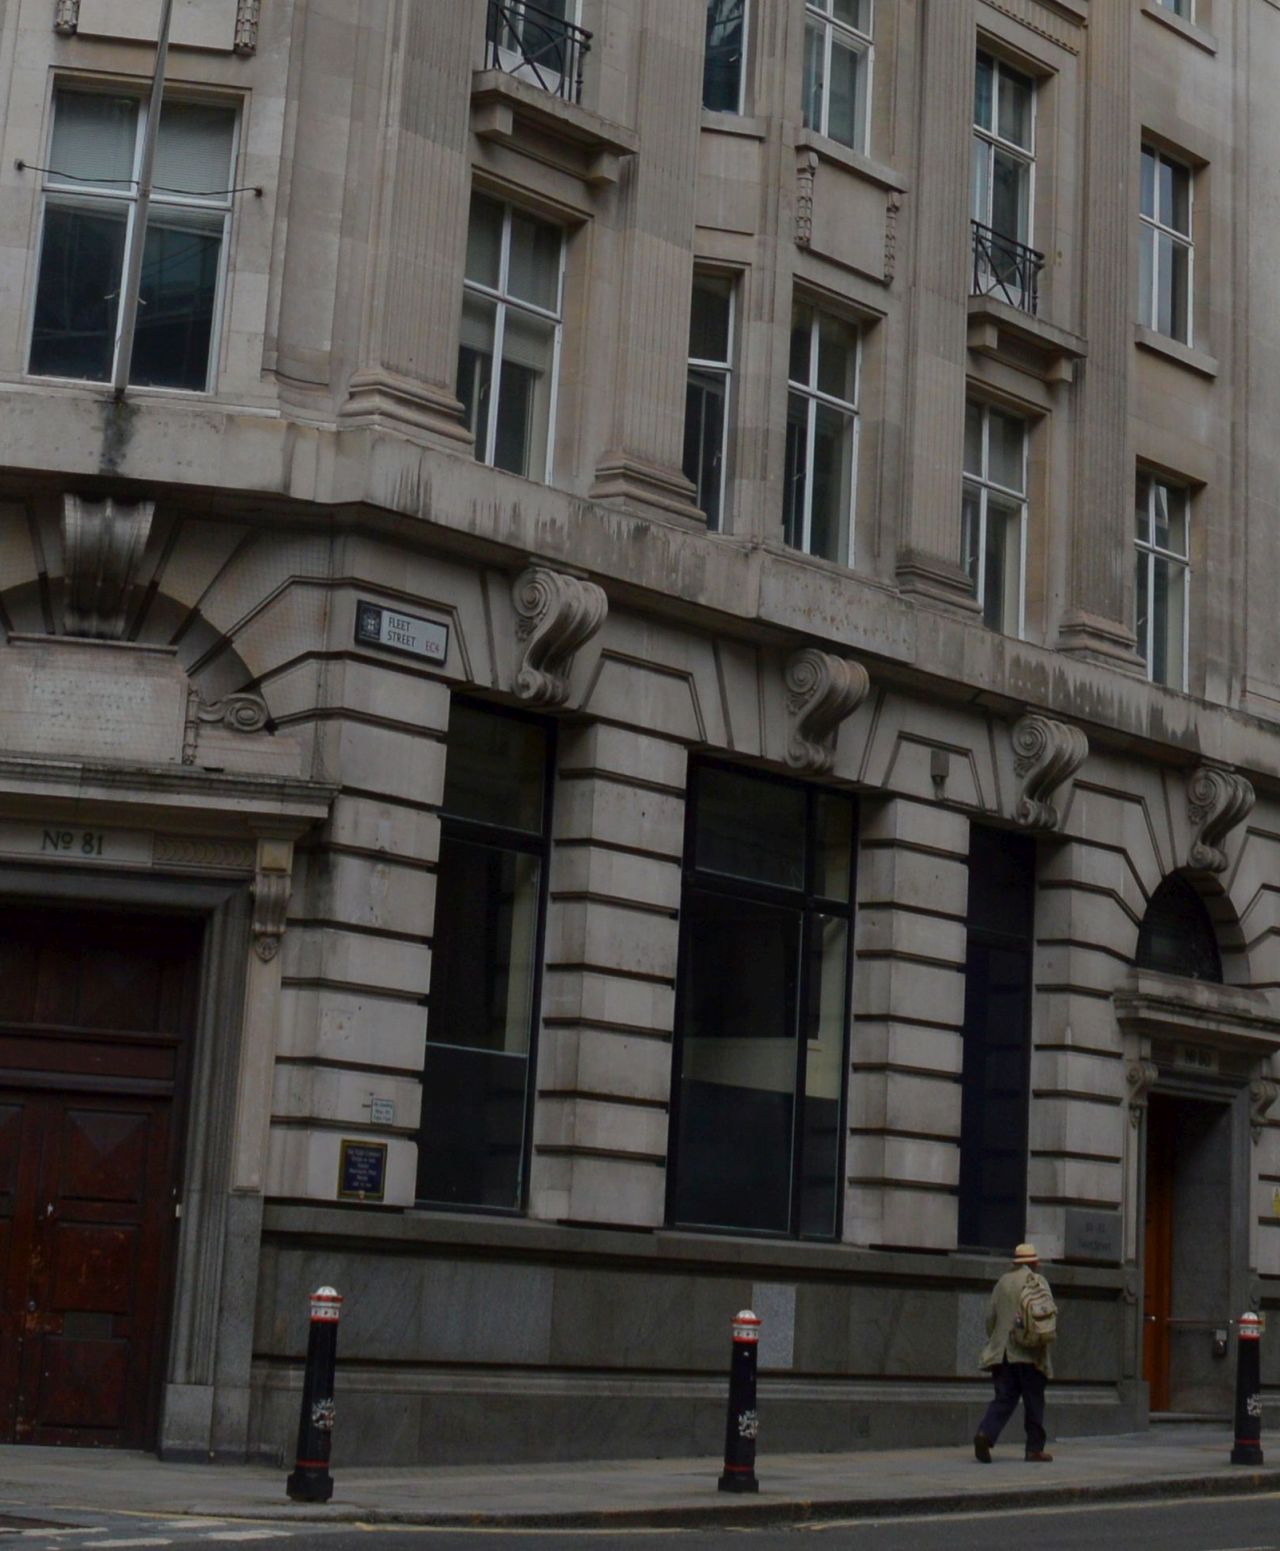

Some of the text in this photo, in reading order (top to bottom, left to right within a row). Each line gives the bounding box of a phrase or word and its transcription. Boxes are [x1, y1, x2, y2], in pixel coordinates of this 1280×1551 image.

[388, 616, 411, 632] FLEET
[387, 631, 440, 653] STREET EC4
[81, 832, 103, 855] 81
